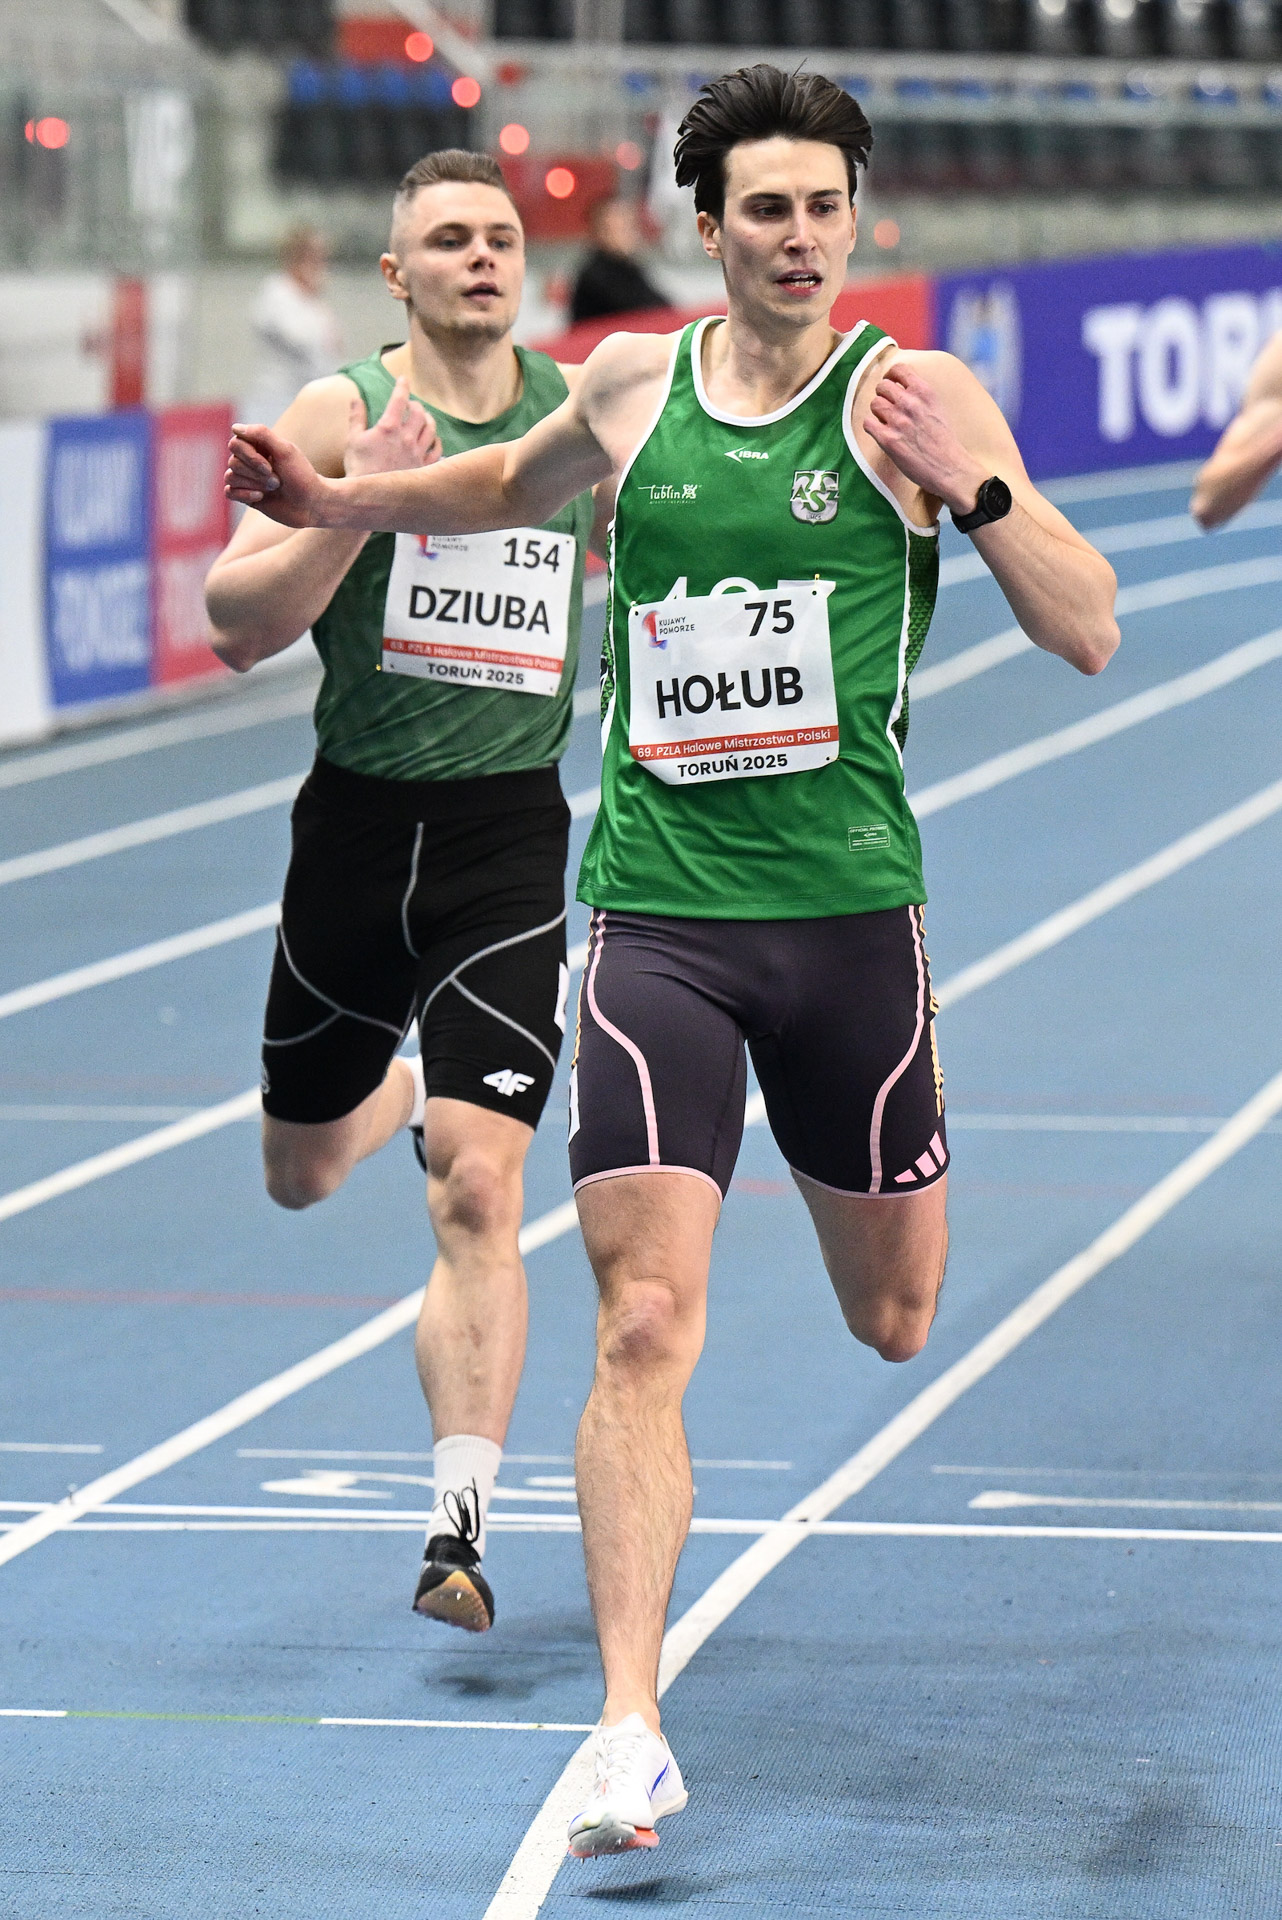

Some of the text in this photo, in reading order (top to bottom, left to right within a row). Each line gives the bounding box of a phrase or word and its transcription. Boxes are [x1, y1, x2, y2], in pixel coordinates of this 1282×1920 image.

[1081, 287, 1282, 444] TOR
[503, 537, 560, 573] 154
[408, 584, 550, 635] DZIUBA
[659, 616, 687, 627] KUJAWY
[744, 599, 795, 637] 75
[659, 623, 696, 635] POMORZE
[433, 645, 474, 659] Halowe
[427, 662, 525, 685] TORUŃ 2025
[656, 666, 803, 719] HOŁUB
[637, 729, 831, 758] 69. PZLA Halowe Mistrzostwa Polski
[677, 753, 788, 778] TORUŃ 2025
[482, 1068, 536, 1096] 4F
